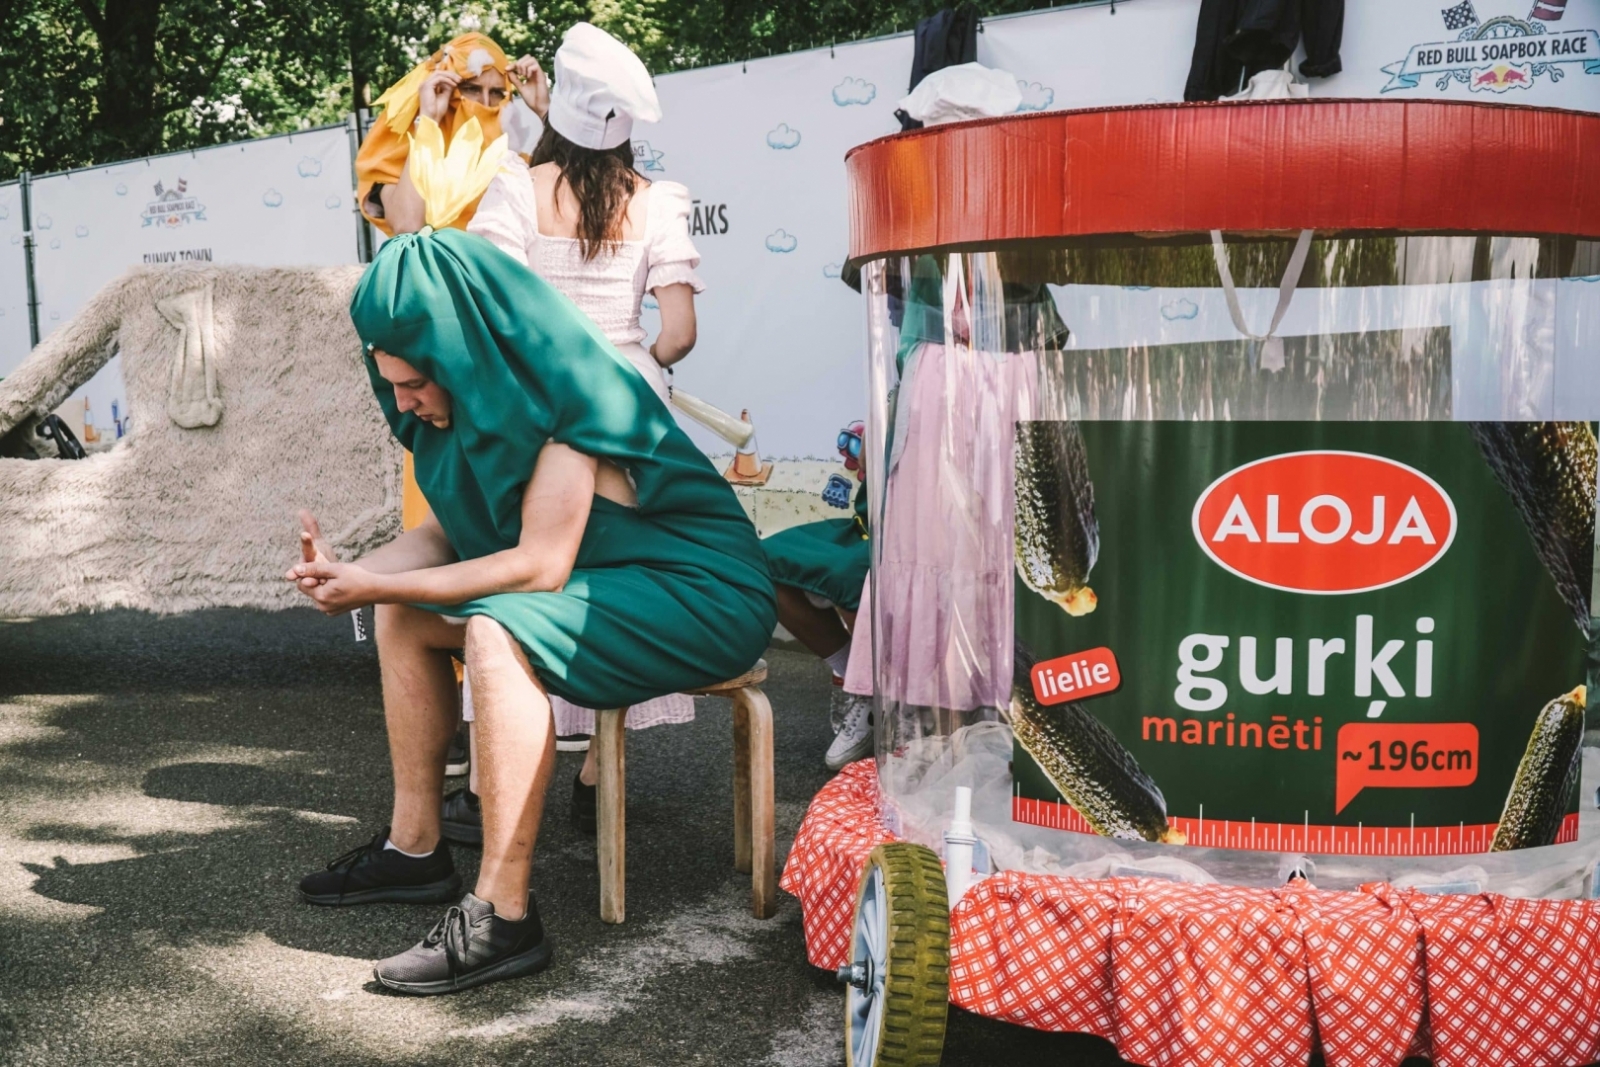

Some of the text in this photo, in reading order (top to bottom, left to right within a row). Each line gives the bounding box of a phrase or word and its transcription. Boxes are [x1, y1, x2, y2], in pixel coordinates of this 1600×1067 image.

[1417, 36, 1588, 66] RED BULL SOAPBOX RACE
[687, 199, 729, 236] ĀKS
[179, 247, 213, 262] TOWN
[1212, 493, 1437, 545] ALOJA
[1037, 660, 1111, 698] lielie
[1173, 614, 1435, 719] gurķi
[1142, 713, 1323, 751] marinēti
